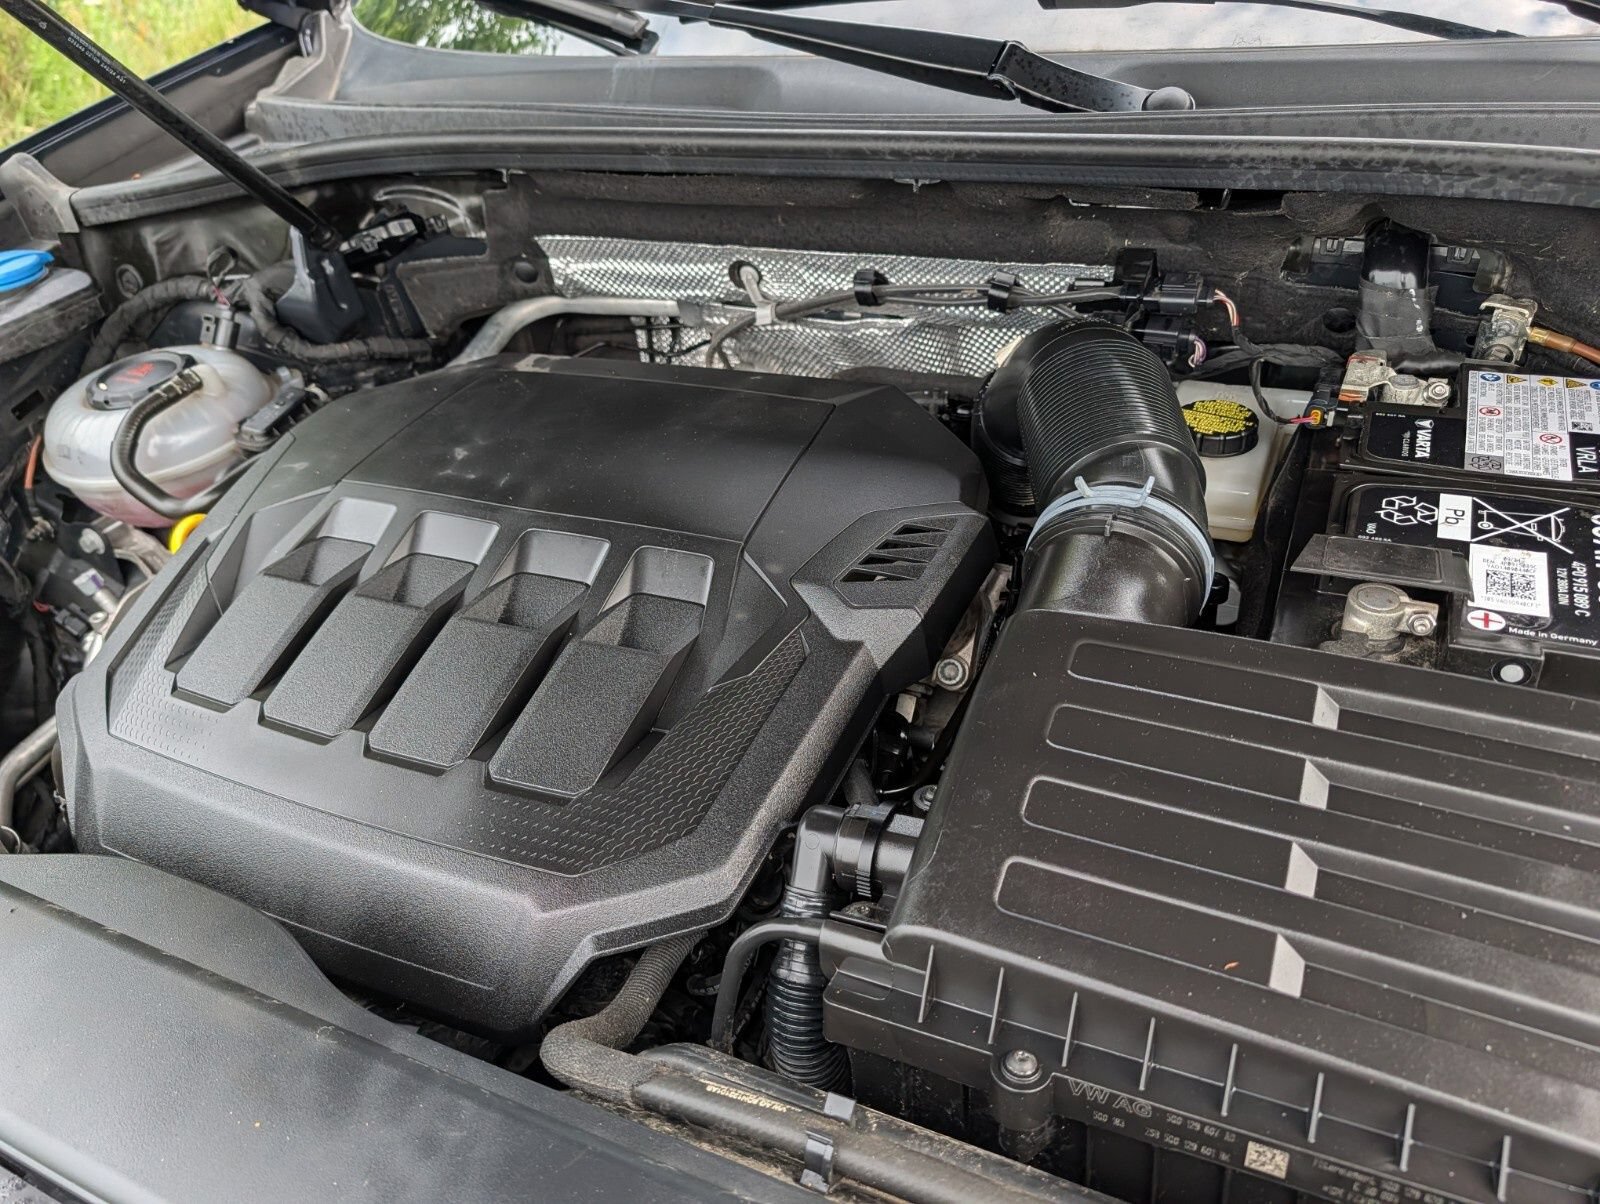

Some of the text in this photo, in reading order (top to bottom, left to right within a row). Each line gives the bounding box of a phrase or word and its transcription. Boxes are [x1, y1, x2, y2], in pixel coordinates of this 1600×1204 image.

[1401, 438, 1410, 457] CLARIOS
[1414, 428, 1432, 458] VARTA
[1575, 446, 1598, 473] VRLA
[1446, 507, 1465, 525] Pb
[1557, 567, 1567, 578] 12V
[1571, 561, 1587, 577] 4P0
[1573, 578, 1588, 593] 915
[1558, 594, 1569, 606] DIN
[1574, 594, 1590, 610] 089
[1508, 626, 1598, 647] Made in Germany
[1068, 1078, 1153, 1118] VW AG
